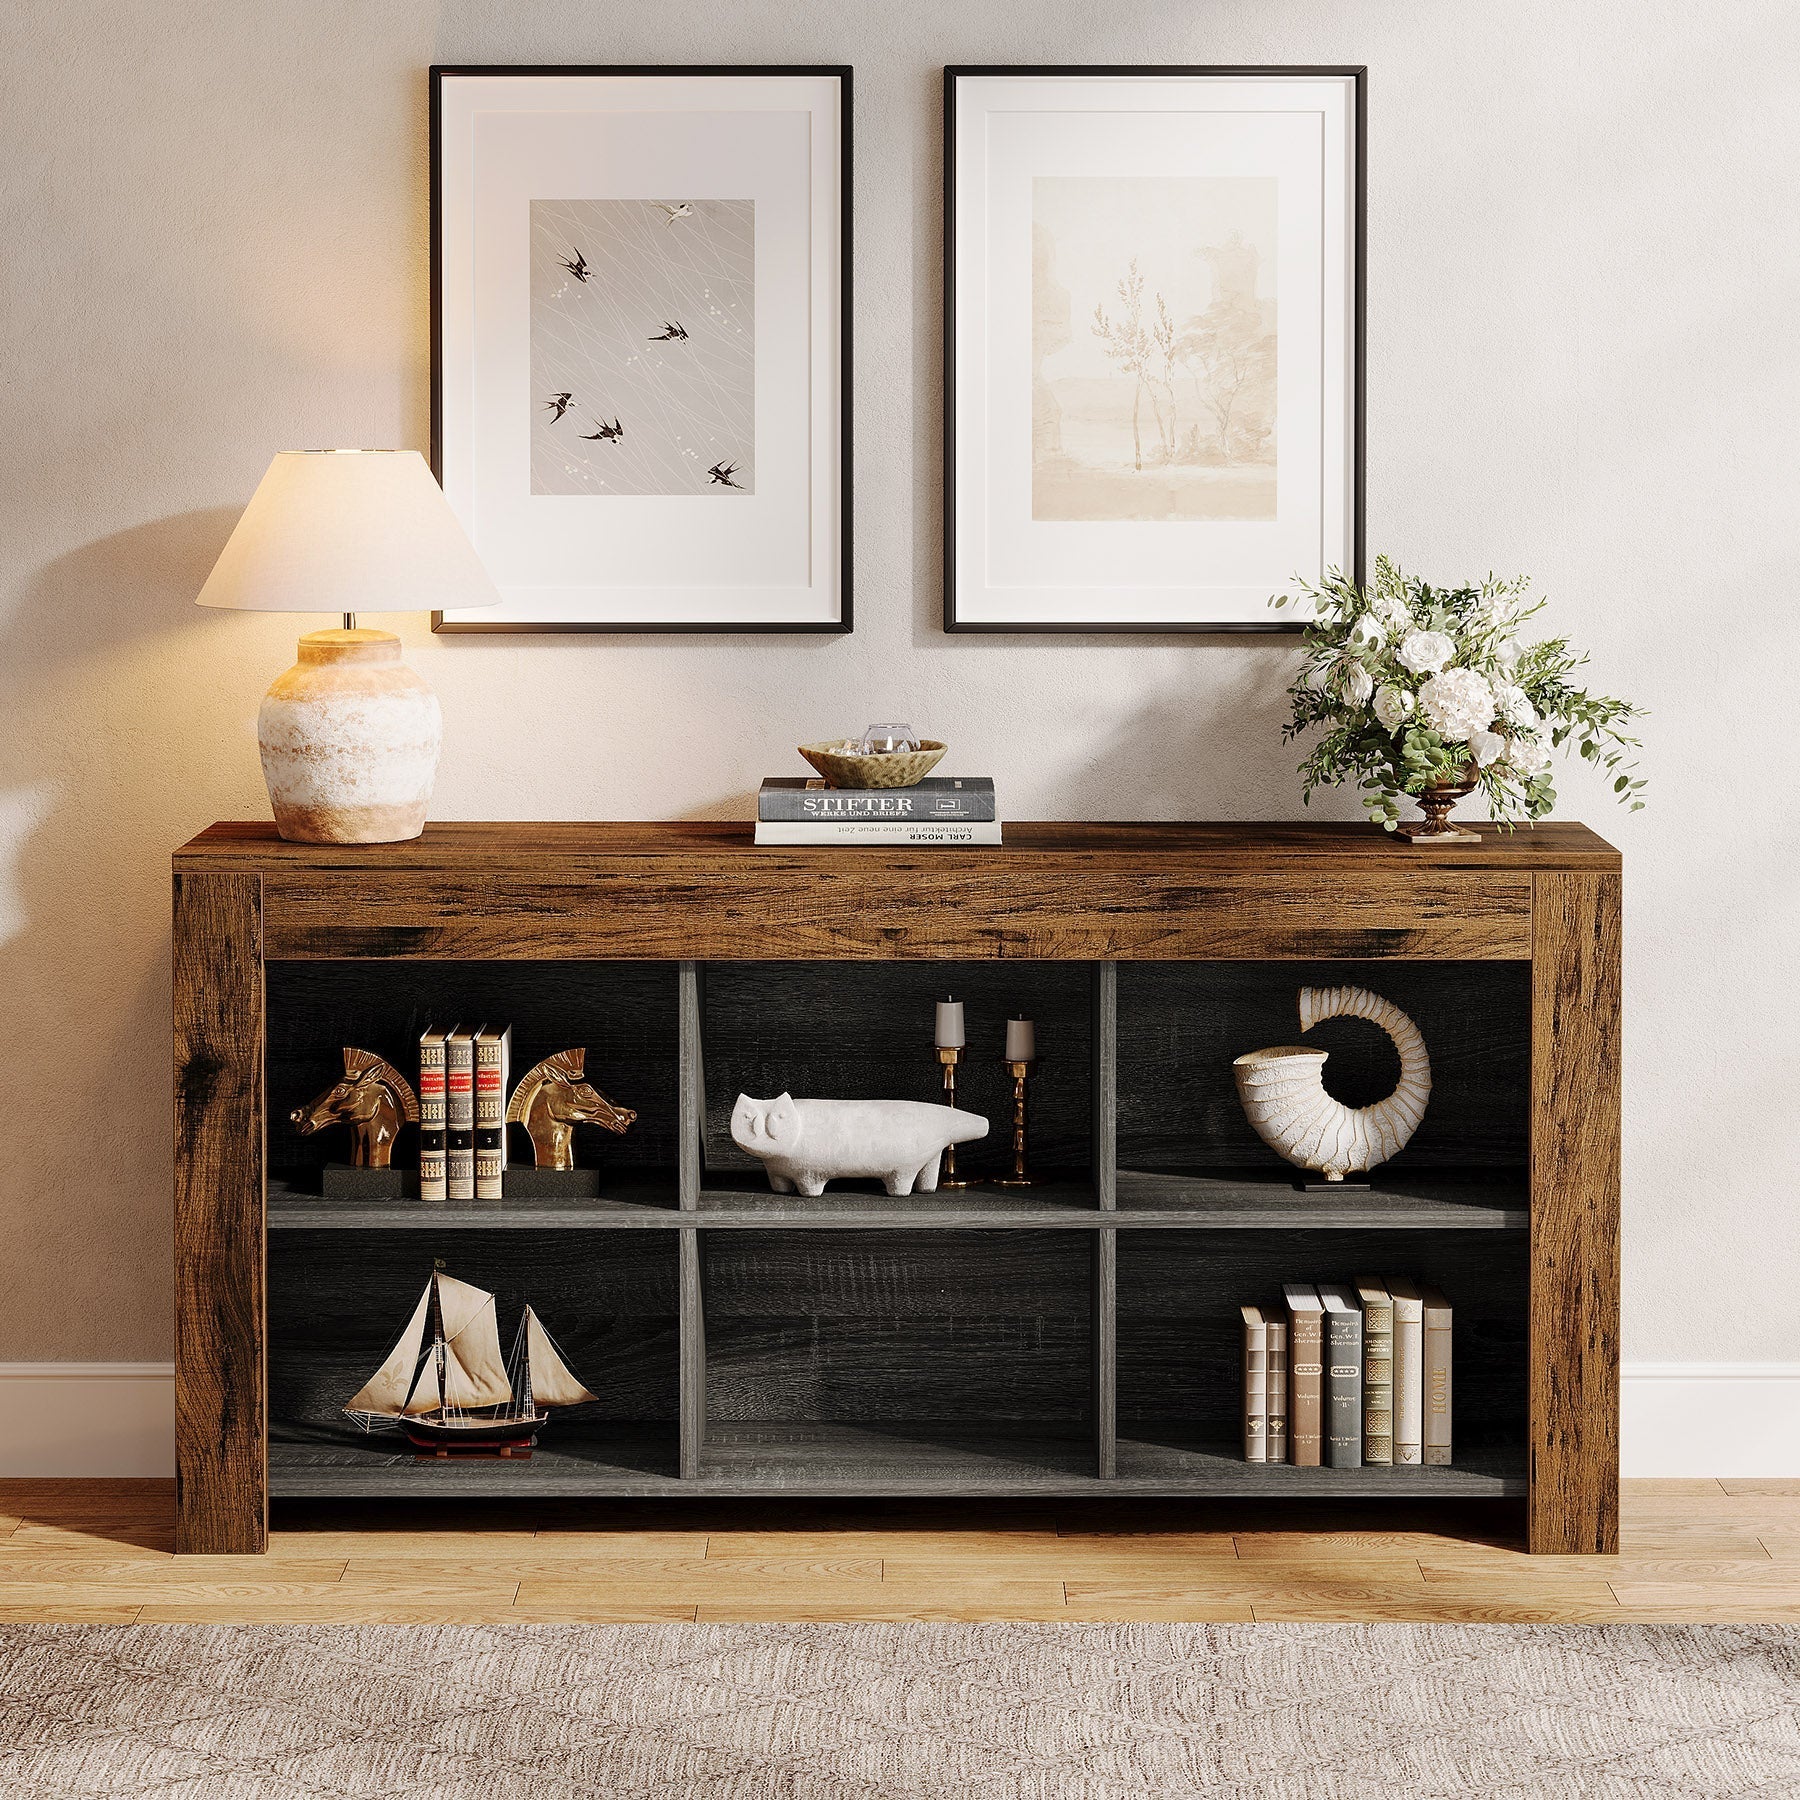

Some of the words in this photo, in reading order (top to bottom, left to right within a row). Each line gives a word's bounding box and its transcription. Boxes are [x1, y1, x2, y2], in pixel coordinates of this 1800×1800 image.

[803, 798, 913, 811] STIFTER
[838, 826, 856, 834] Zeit
[906, 826, 919, 834] für
[922, 826, 973, 834] Architektur
[1431, 1367, 1447, 1414] HOME
